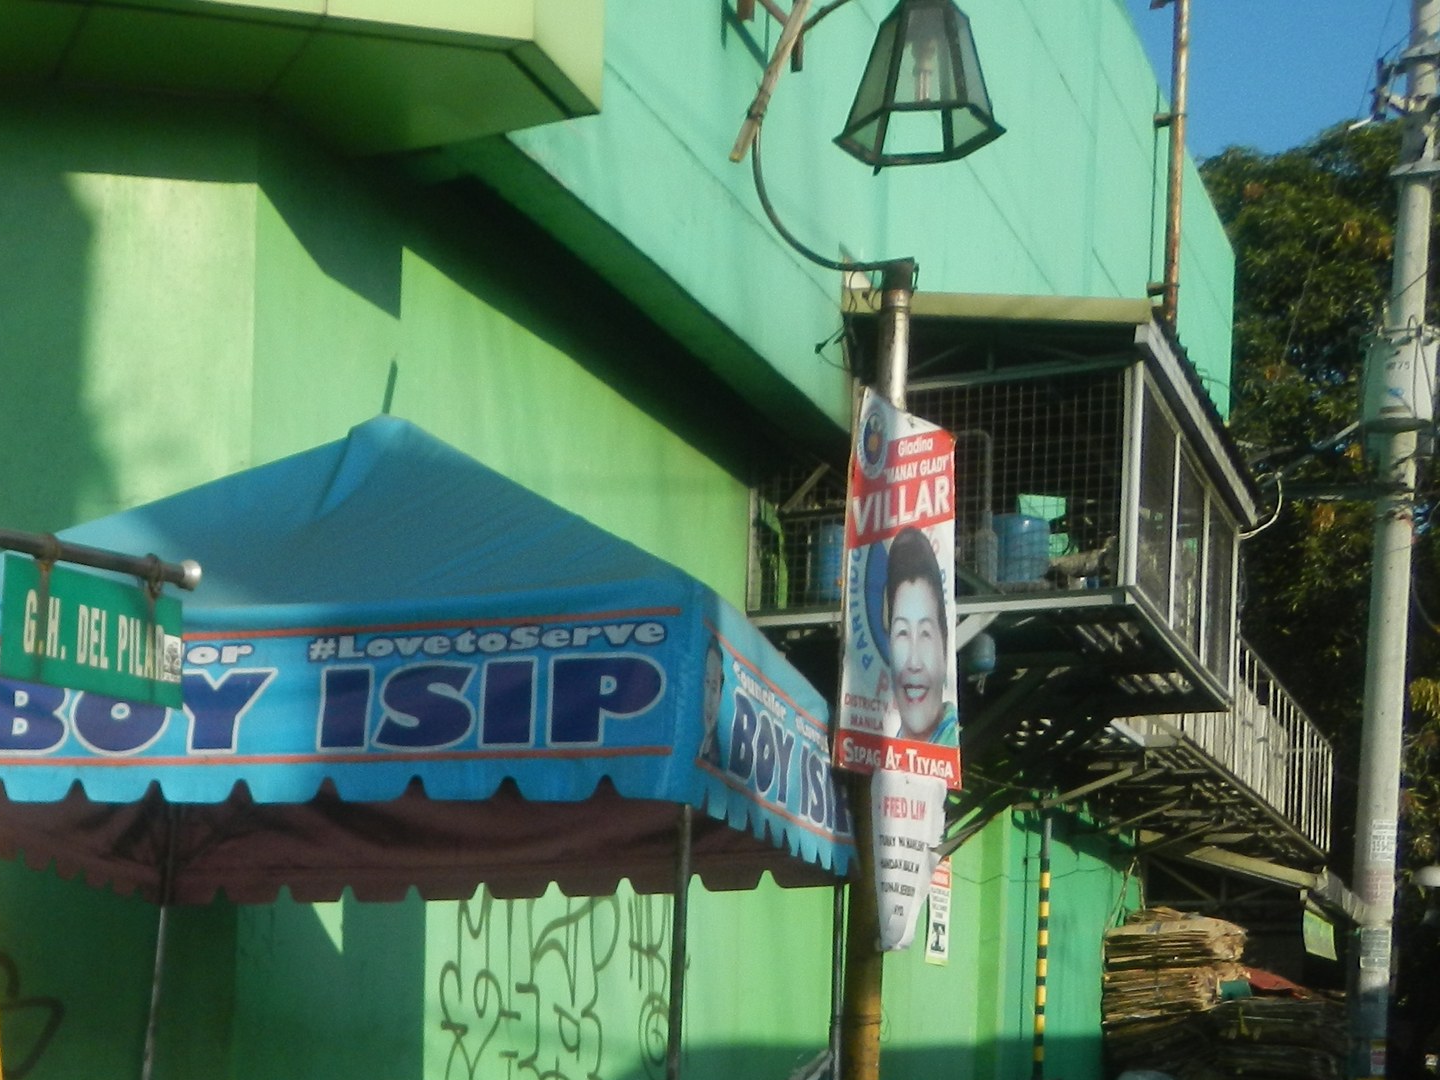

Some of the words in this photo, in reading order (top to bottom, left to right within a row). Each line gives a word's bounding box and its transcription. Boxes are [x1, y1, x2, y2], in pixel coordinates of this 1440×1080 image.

[898, 436, 934, 457] Gladina
[852, 475, 951, 536] VILLAR
[23, 589, 67, 660] G.H.
[76, 603, 109, 669] DEL
[308, 621, 667, 662] #LovetoServe
[315, 651, 667, 754] ISIP
[726, 685, 796, 809] BOY
[842, 736, 882, 768] SIPAG
[885, 745, 902, 770] AT
[906, 747, 954, 779] TIYAGA
[882, 796, 908, 819] FRED
